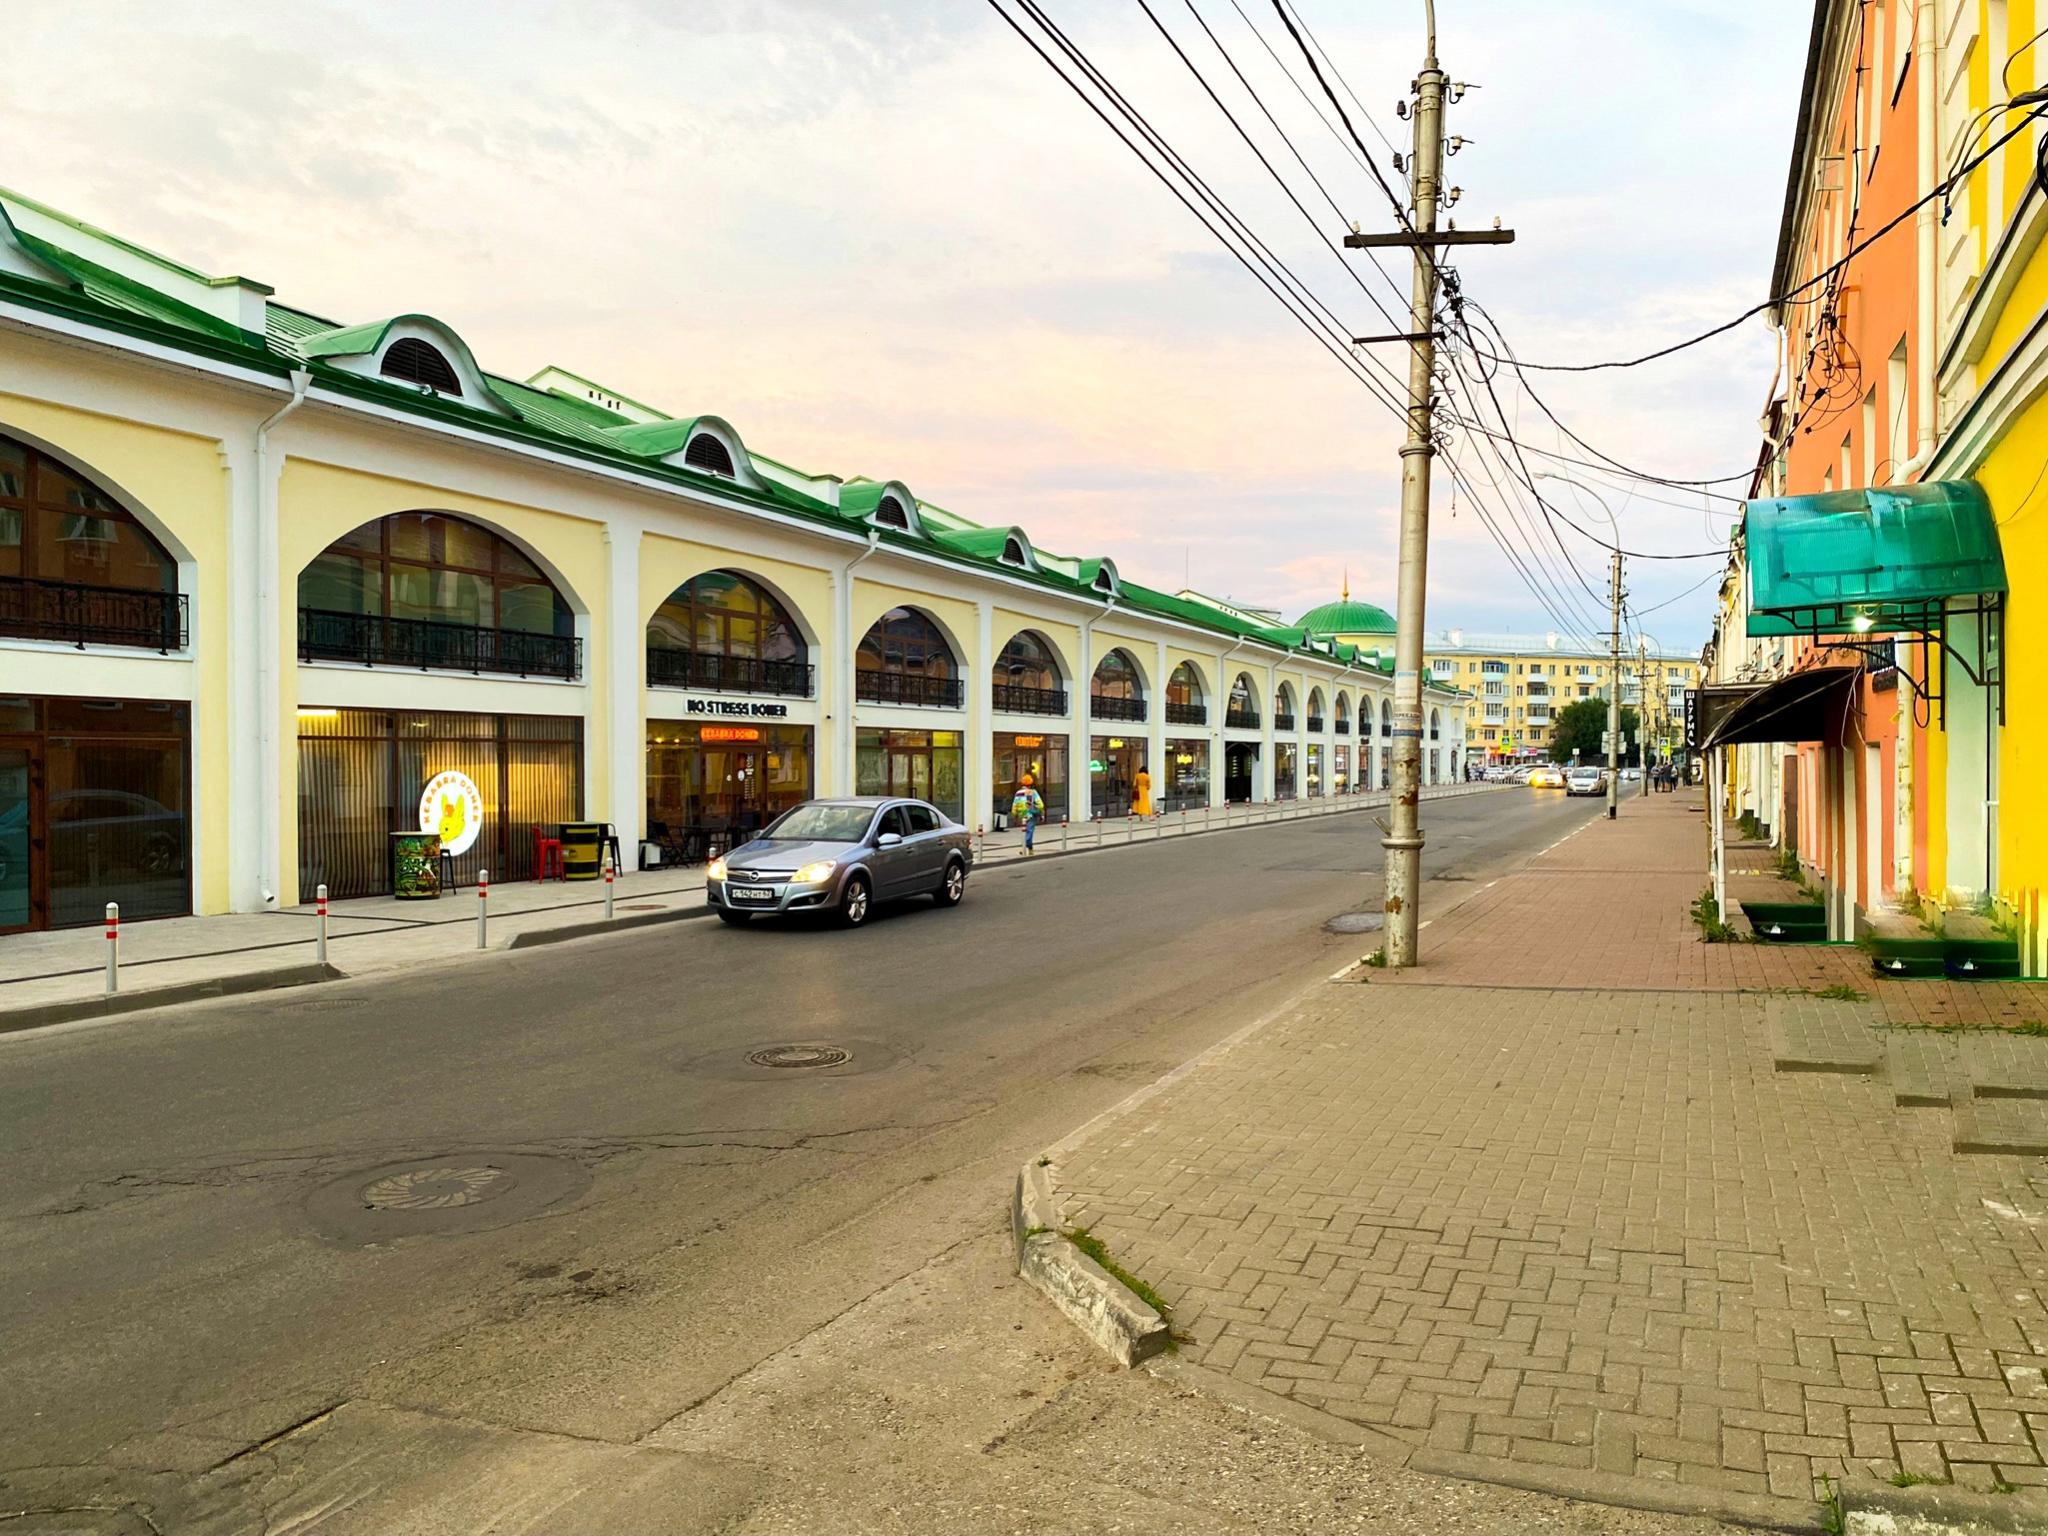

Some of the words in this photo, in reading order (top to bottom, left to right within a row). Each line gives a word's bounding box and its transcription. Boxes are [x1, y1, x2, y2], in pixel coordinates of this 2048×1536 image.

[687, 699, 705, 713] NO
[706, 701, 749, 716] STRESS
[1686, 691, 1695, 737] ШАУРМА
